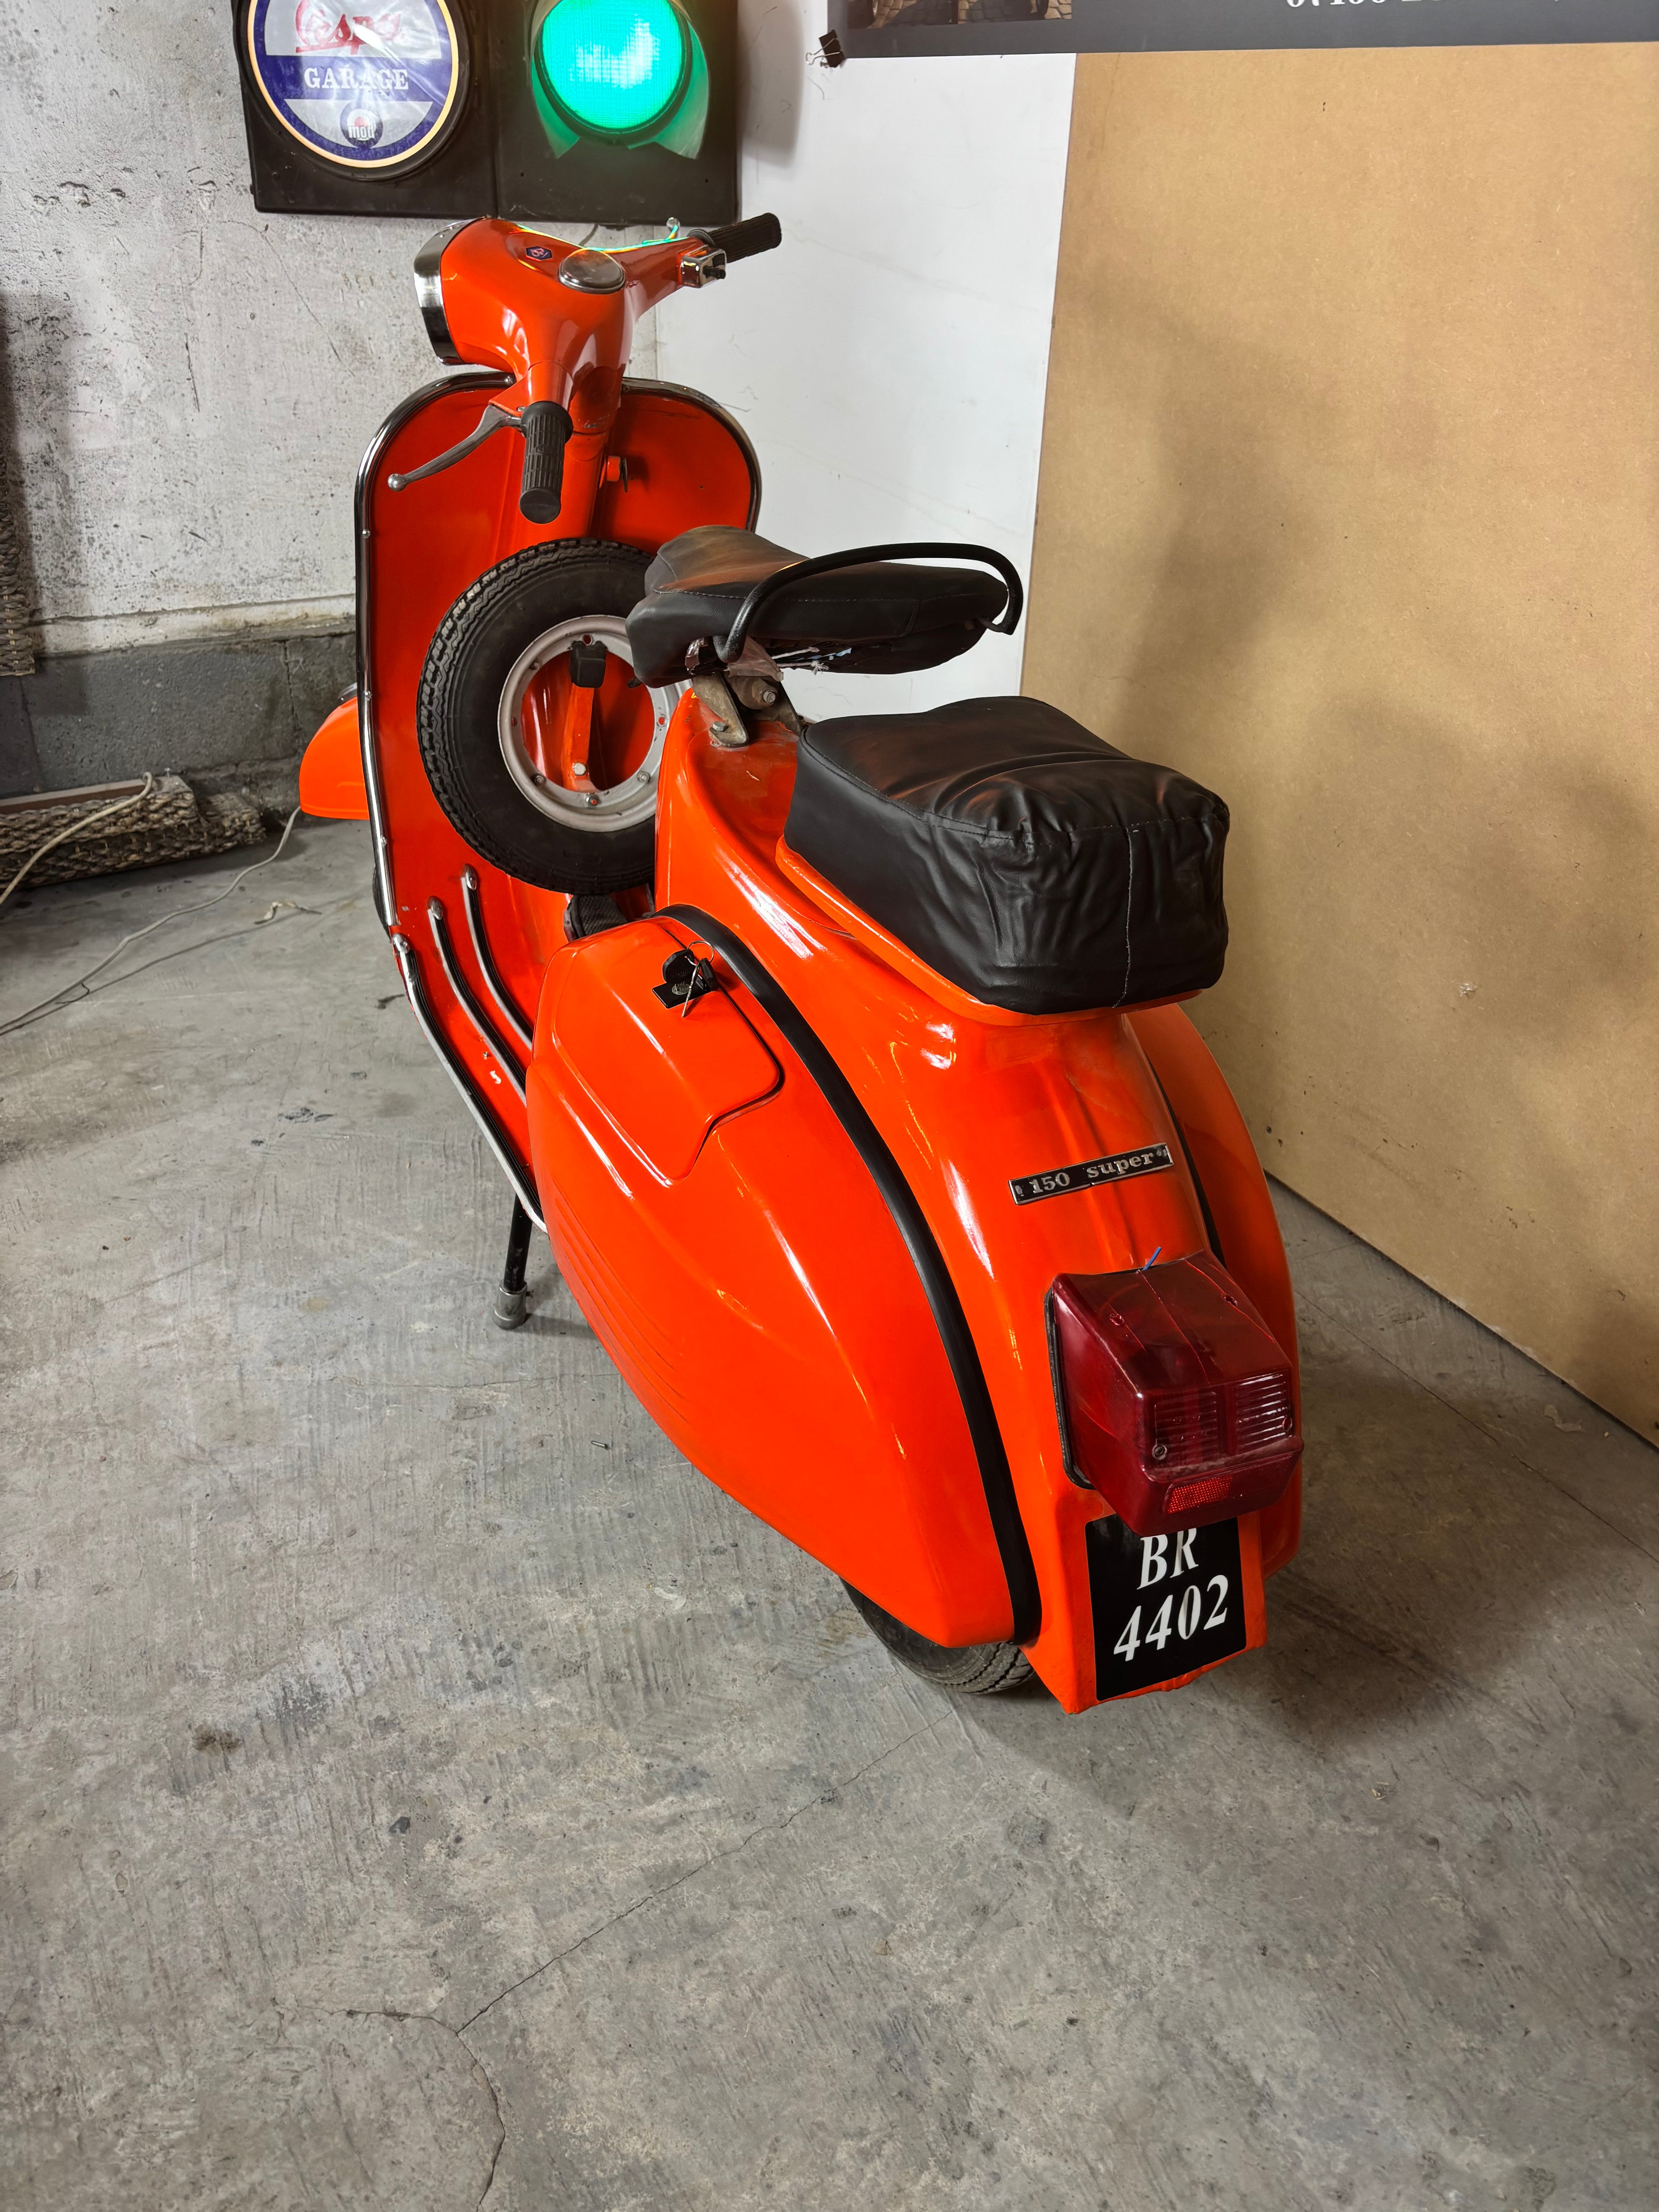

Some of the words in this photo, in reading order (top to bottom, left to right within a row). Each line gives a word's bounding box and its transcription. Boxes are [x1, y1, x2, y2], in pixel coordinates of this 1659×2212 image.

[304, 68, 408, 90] GARAGE
[348, 121, 375, 139] mod
[1029, 1172, 1070, 1193] 150
[1087, 1151, 1154, 1178] super
[1136, 1527, 1199, 1590] BR
[1113, 1575, 1228, 1662] 4402
